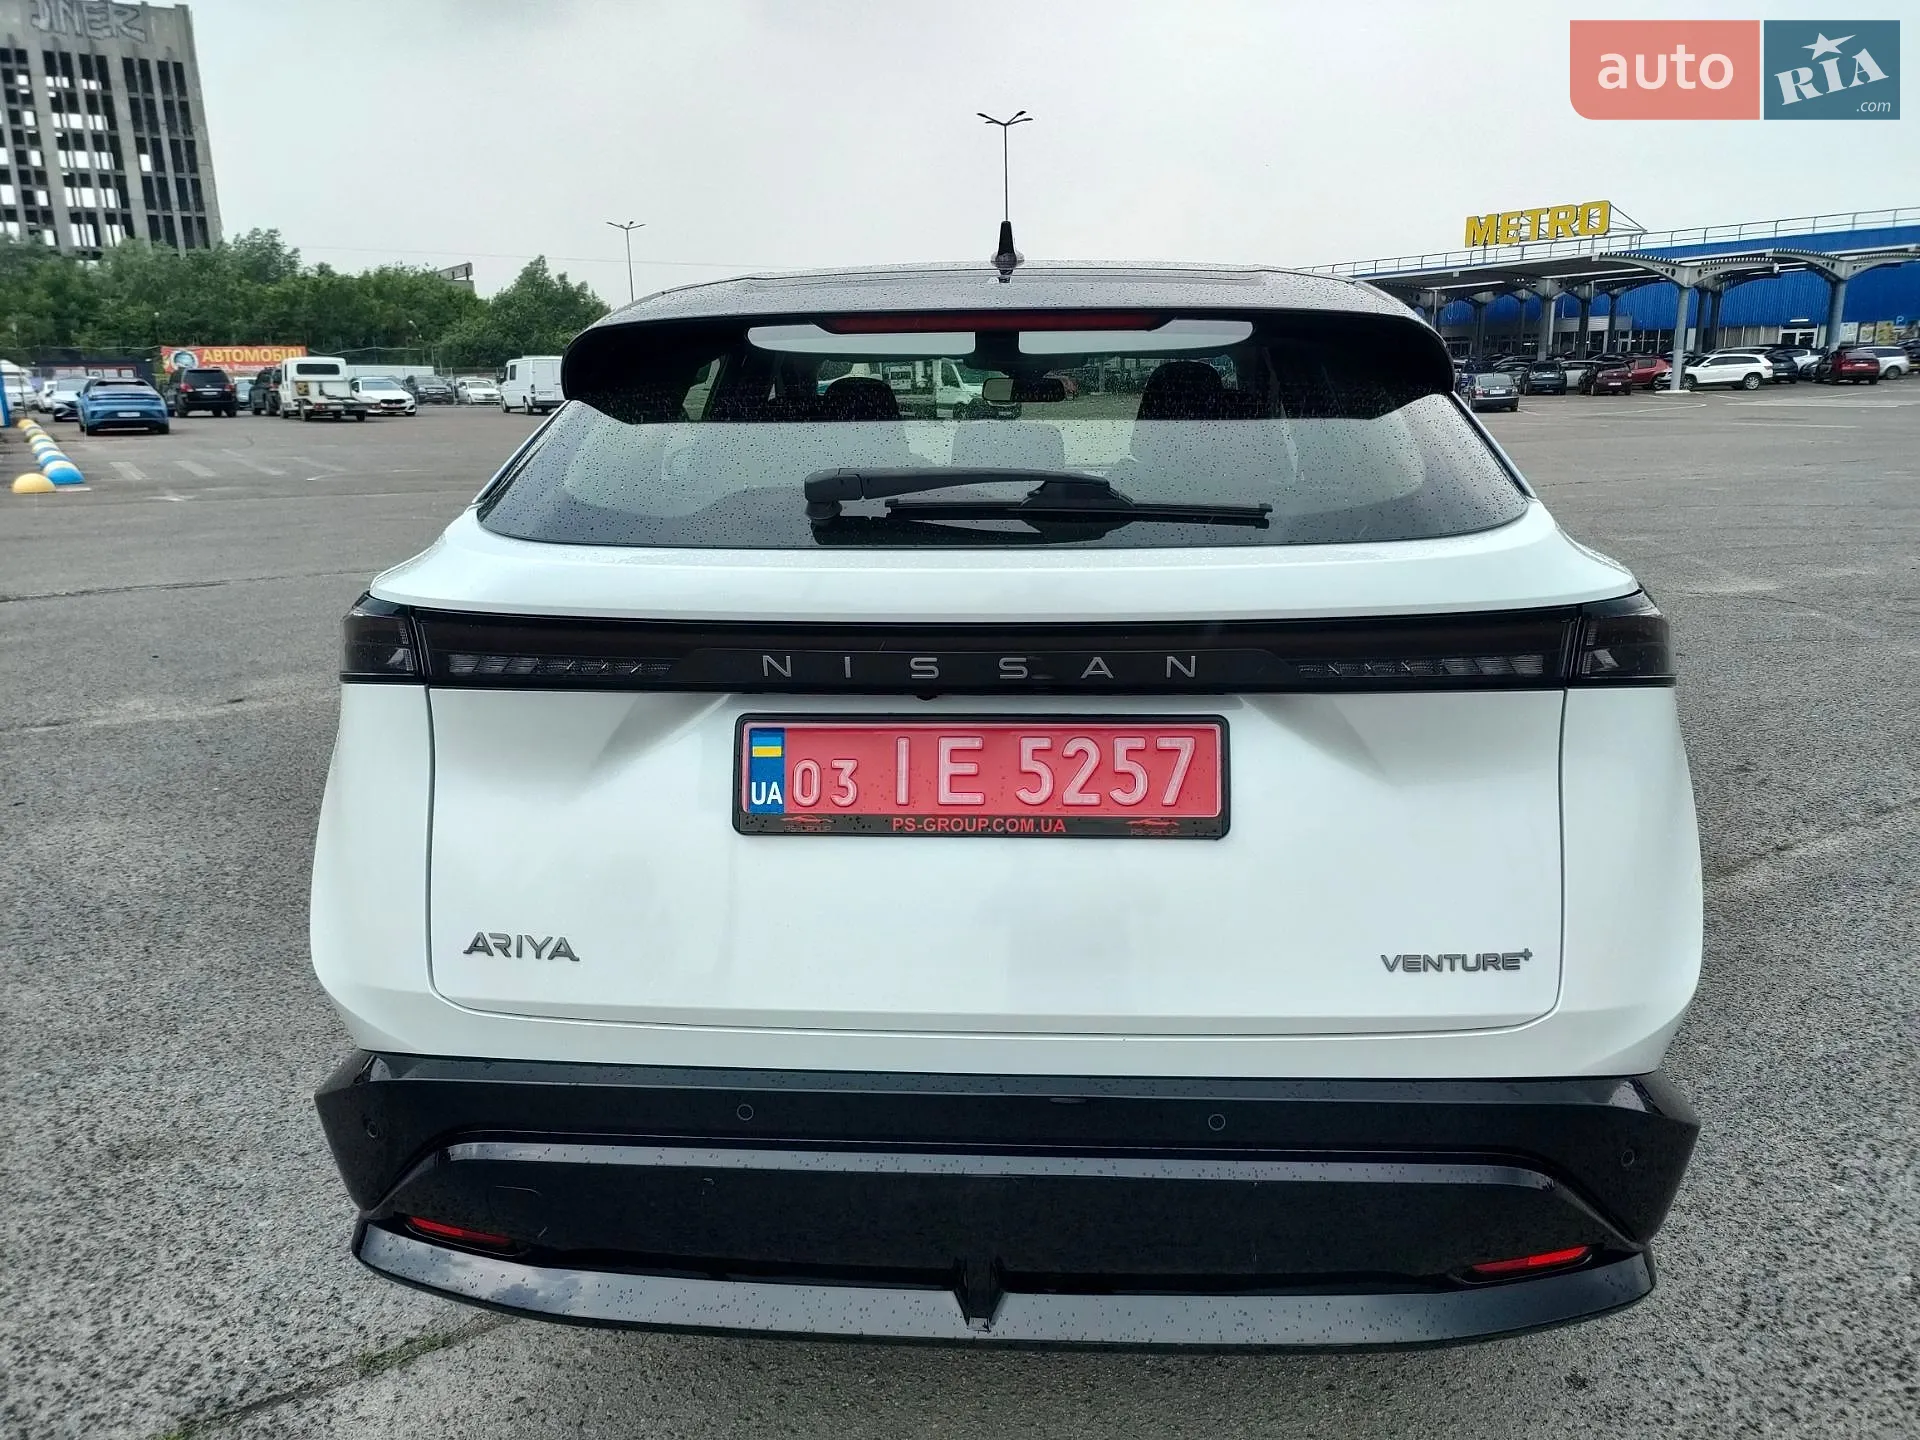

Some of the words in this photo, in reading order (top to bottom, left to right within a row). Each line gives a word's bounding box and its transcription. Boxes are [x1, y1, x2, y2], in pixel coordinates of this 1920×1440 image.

[1465, 199, 1612, 248] METRO
[762, 654, 1197, 680] NISSAN
[792, 759, 860, 808] 03
[895, 735, 987, 808] IE
[1014, 735, 1197, 808] 5257
[750, 781, 783, 806] UA
[892, 817, 1067, 835] PS-GROUP.COM.UA
[462, 931, 580, 962] ARIYA
